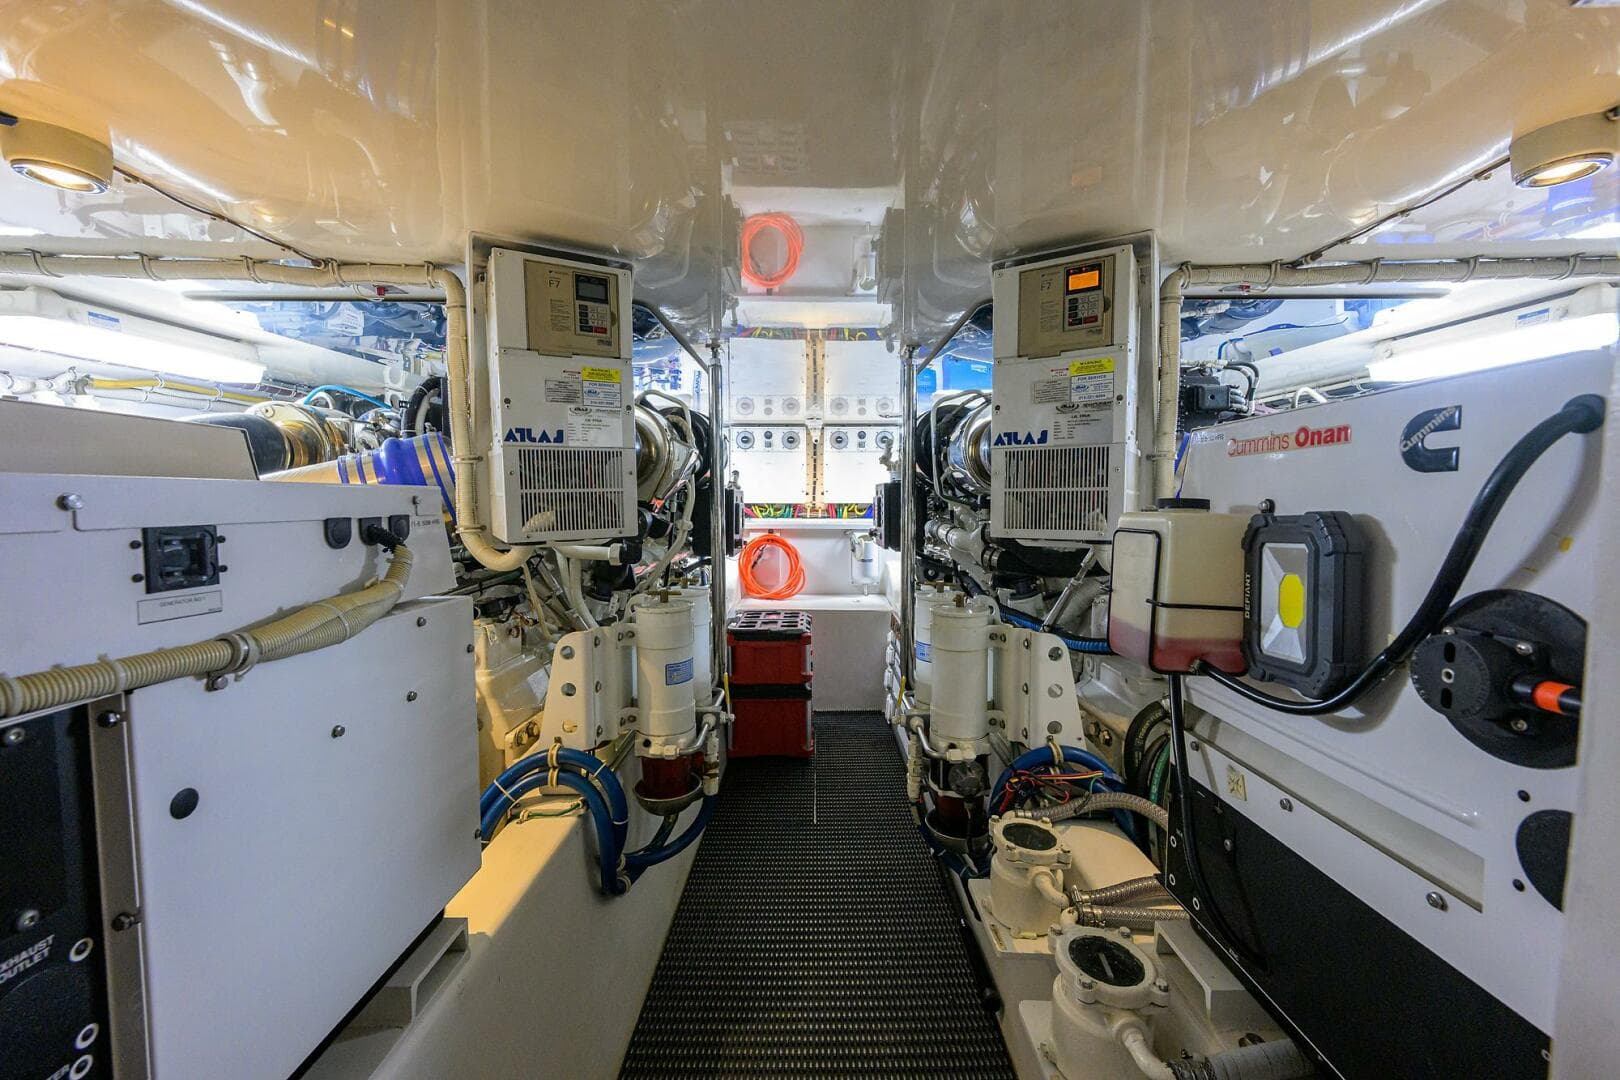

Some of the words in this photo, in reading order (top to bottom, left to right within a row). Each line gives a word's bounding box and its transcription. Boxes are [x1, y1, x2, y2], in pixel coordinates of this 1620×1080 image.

[503, 427, 564, 444] ATLAS
[993, 429, 1049, 446] ATLAS
[1227, 433, 1290, 457] Cummins
[1294, 425, 1351, 448] Onan
[1400, 405, 1456, 453] Cummins
